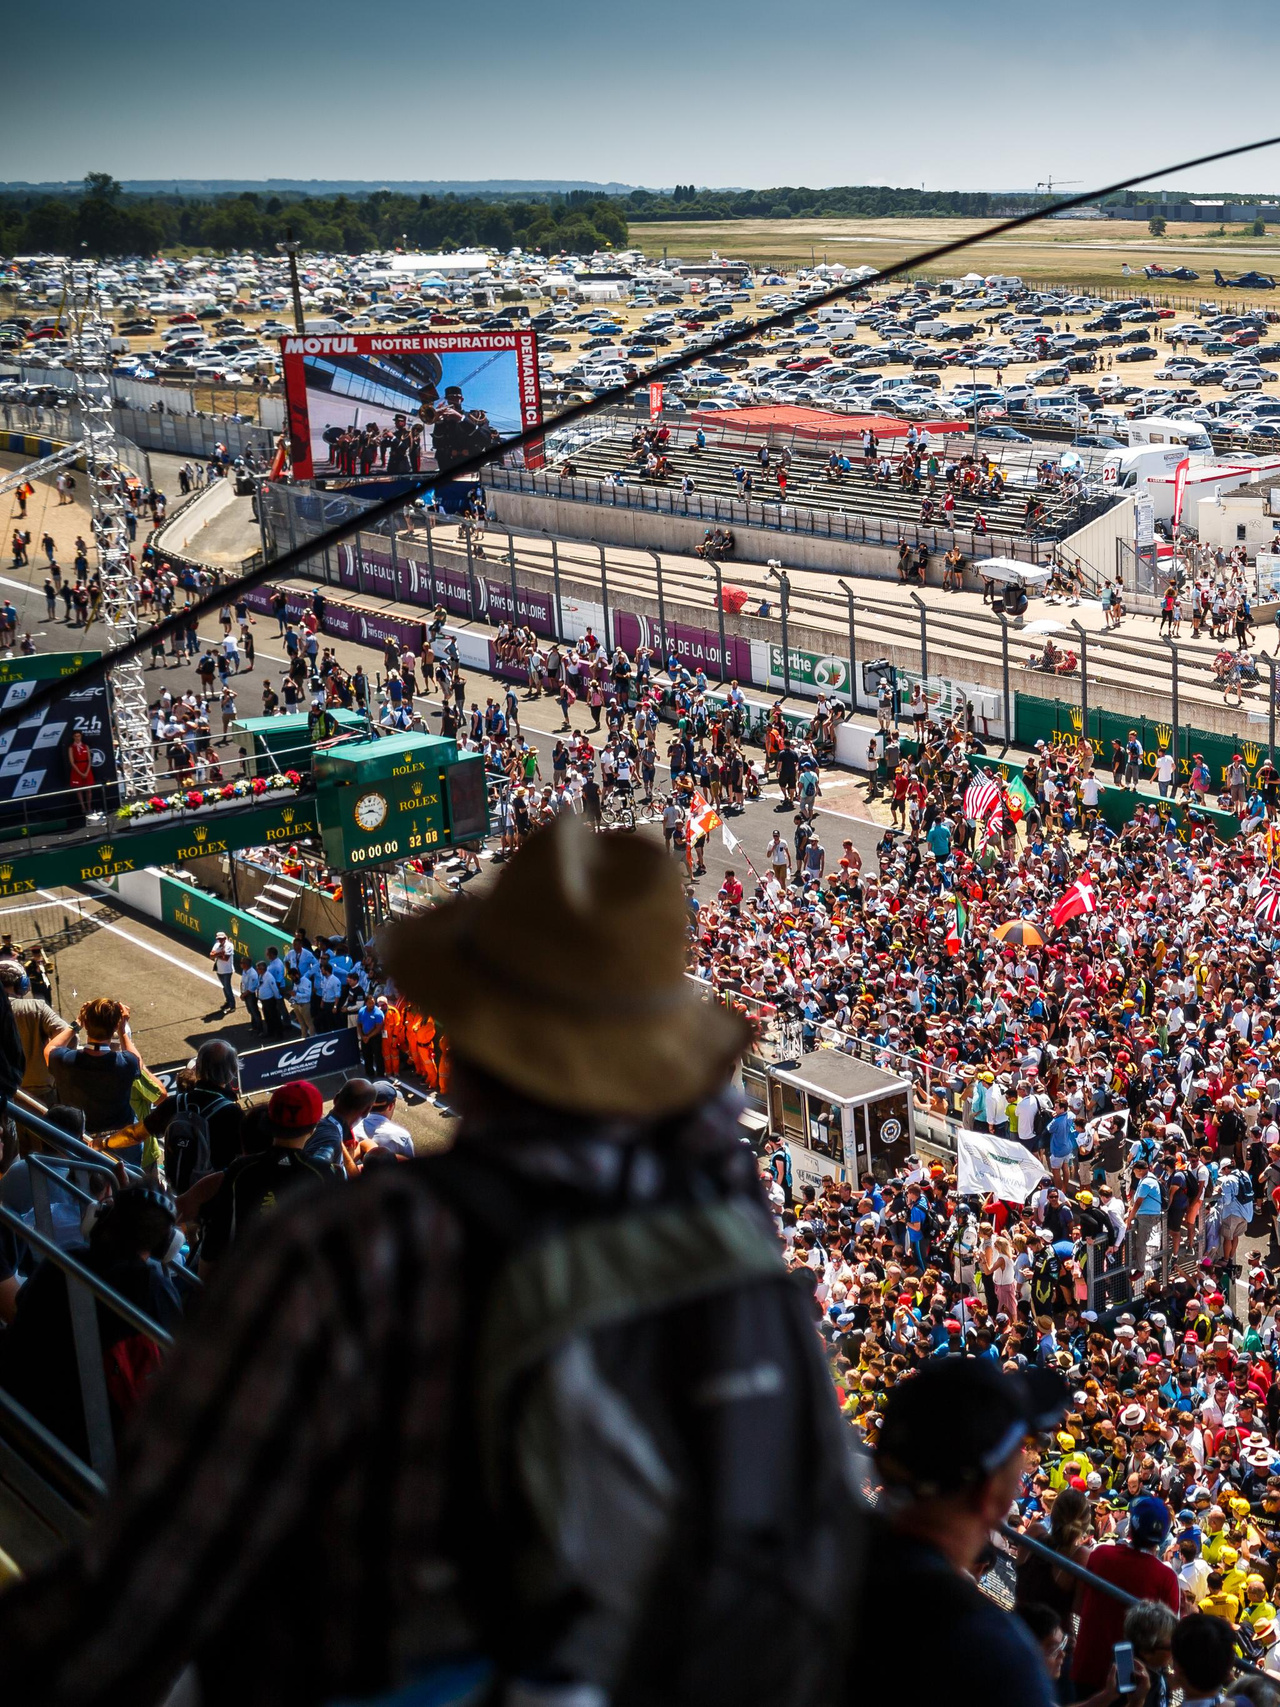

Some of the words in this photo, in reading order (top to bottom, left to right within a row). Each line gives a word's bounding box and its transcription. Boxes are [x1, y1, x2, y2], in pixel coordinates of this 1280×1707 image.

[284, 337, 358, 354] MOTUL
[371, 338, 422, 351] NOTRE
[423, 335, 516, 349] INSPIRATION
[520, 336, 538, 409] DEMARRE
[524, 410, 538, 425] ICI
[1104, 467, 1117, 481] 22
[490, 594, 507, 611] PAYS
[516, 600, 527, 615] LA
[528, 603, 547, 621] LOIRE
[654, 635, 676, 652] PYS
[677, 641, 690, 655] DE
[691, 644, 703, 659] LA
[705, 648, 732, 666] LOIE
[0, 672, 24, 683] OLEX
[392, 762, 426, 776] ROLEX
[399, 794, 438, 812] ROLEX
[409, 834, 422, 848] 32
[0, 879, 36, 896] LEX
[80, 859, 135, 880] ROLEX
[177, 840, 228, 860] ROLEX
[265, 821, 313, 841] ROLEX
[351, 850, 366, 863] 00
[368, 845, 382, 859] 00
[384, 840, 399, 853] 00
[175, 909, 200, 933] ROLEX
[230, 936, 250, 957] OLEX
[277, 1038, 339, 1068] WEC
[270, 1068, 287, 1076] WORLD
[287, 1060, 318, 1072] ENDURANCE
